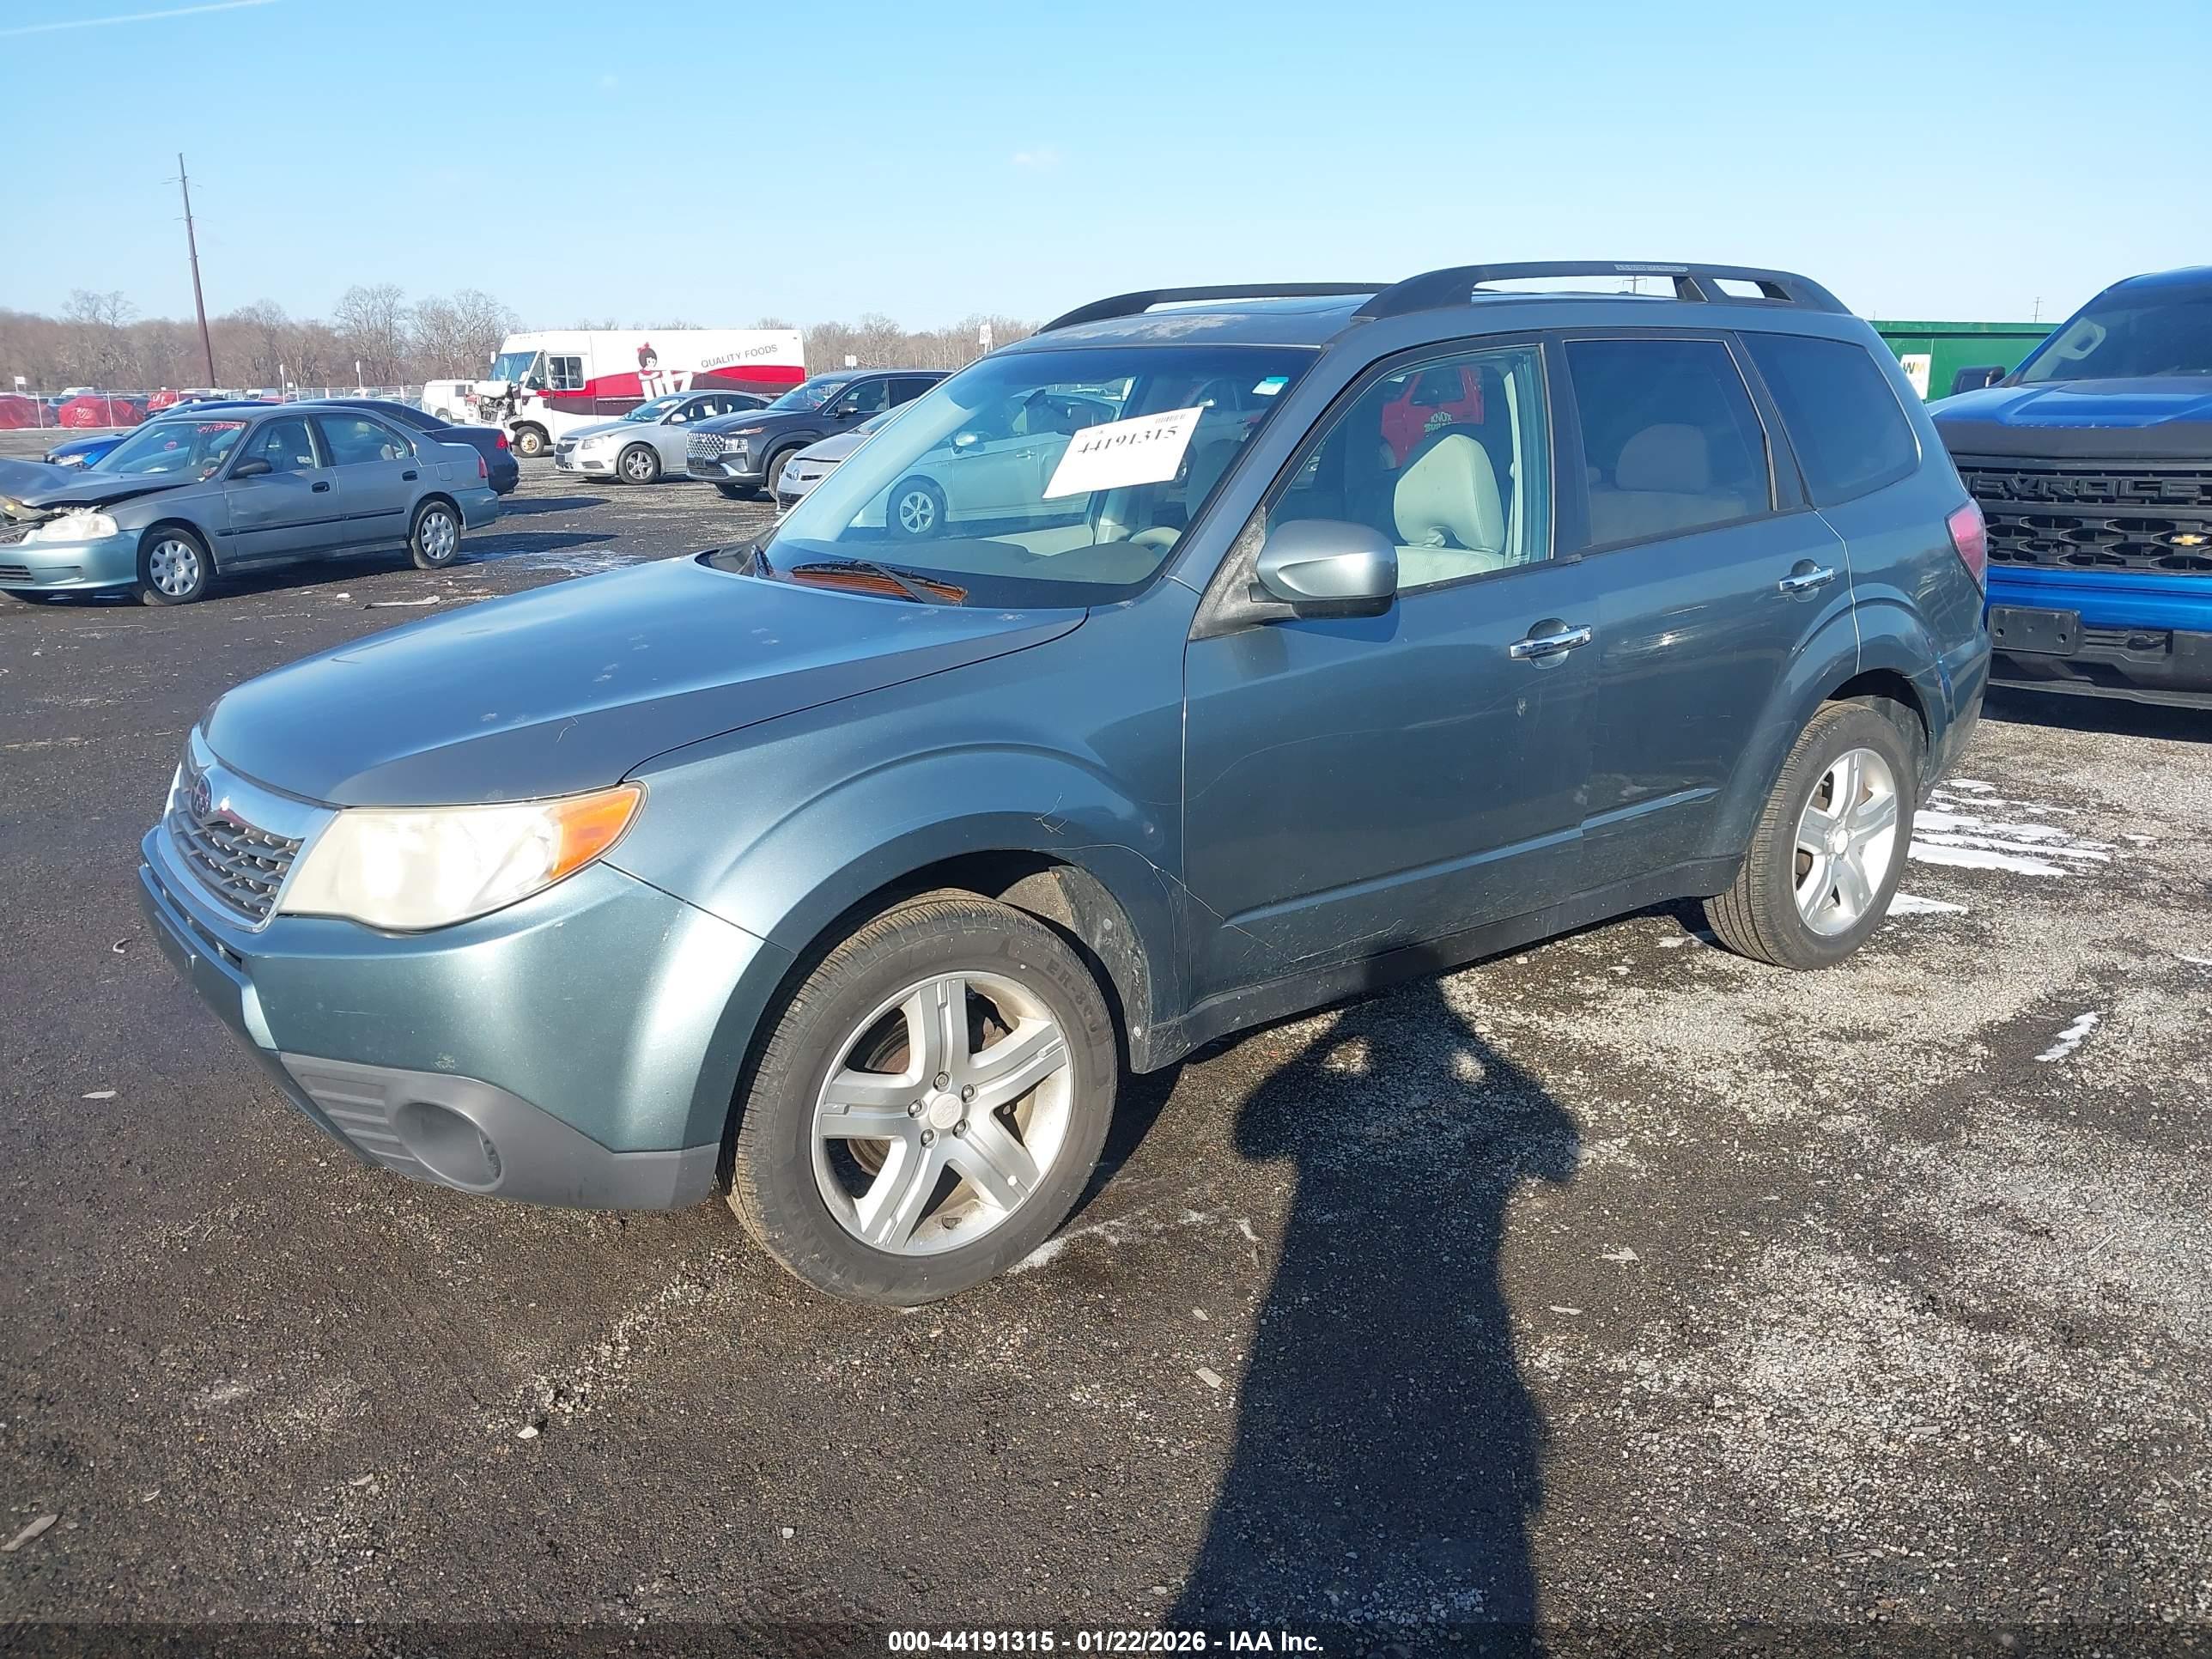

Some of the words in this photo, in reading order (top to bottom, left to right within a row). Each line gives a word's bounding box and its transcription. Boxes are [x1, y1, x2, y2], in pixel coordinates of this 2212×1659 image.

[701, 351, 741, 368] QUALITY
[744, 343, 779, 358] FOODS
[1078, 425, 1180, 454] 44191315
